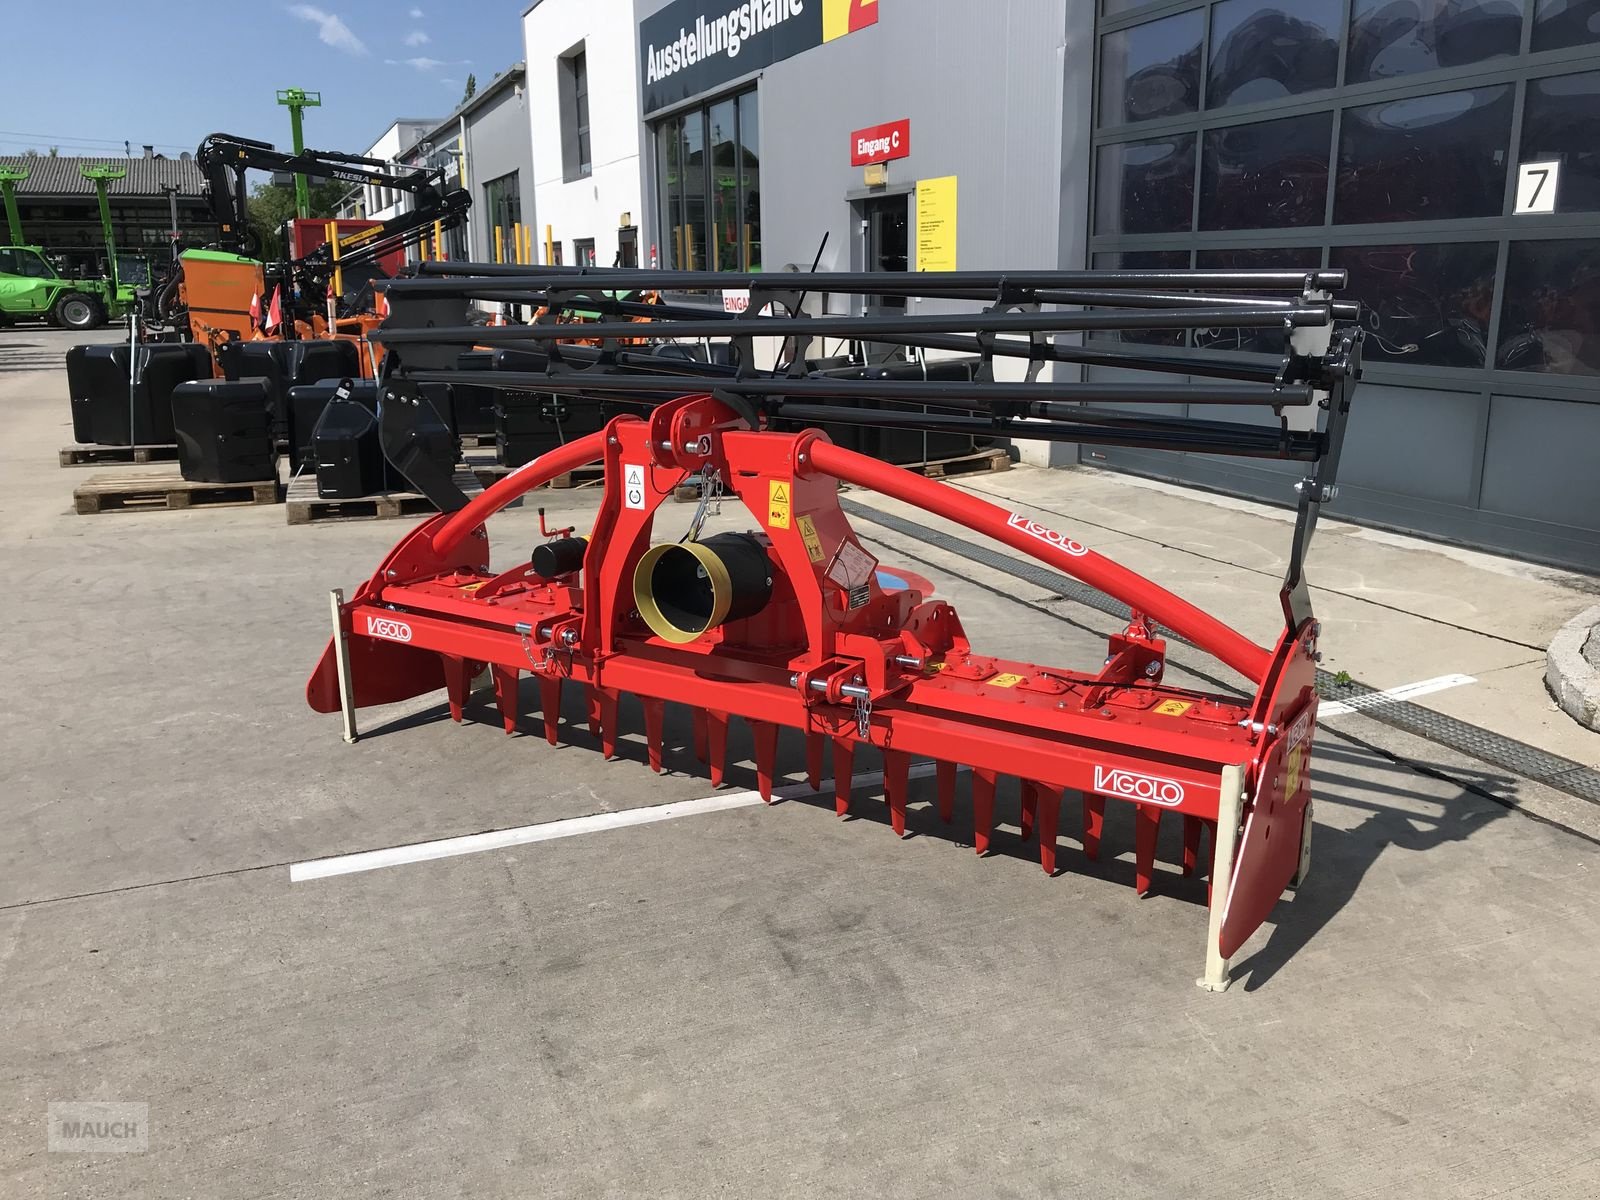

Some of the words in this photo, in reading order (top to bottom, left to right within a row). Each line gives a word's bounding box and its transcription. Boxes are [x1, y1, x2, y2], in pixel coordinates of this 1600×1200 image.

[857, 138, 890, 157] Eingang
[891, 130, 900, 148] C
[340, 171, 370, 184] KESLA
[1527, 169, 1549, 208] 7
[724, 296, 750, 311] EINGA
[1007, 513, 1088, 556] VIGOLO
[367, 616, 412, 641] VIGOLO
[1093, 765, 1184, 806] VIGOLO
